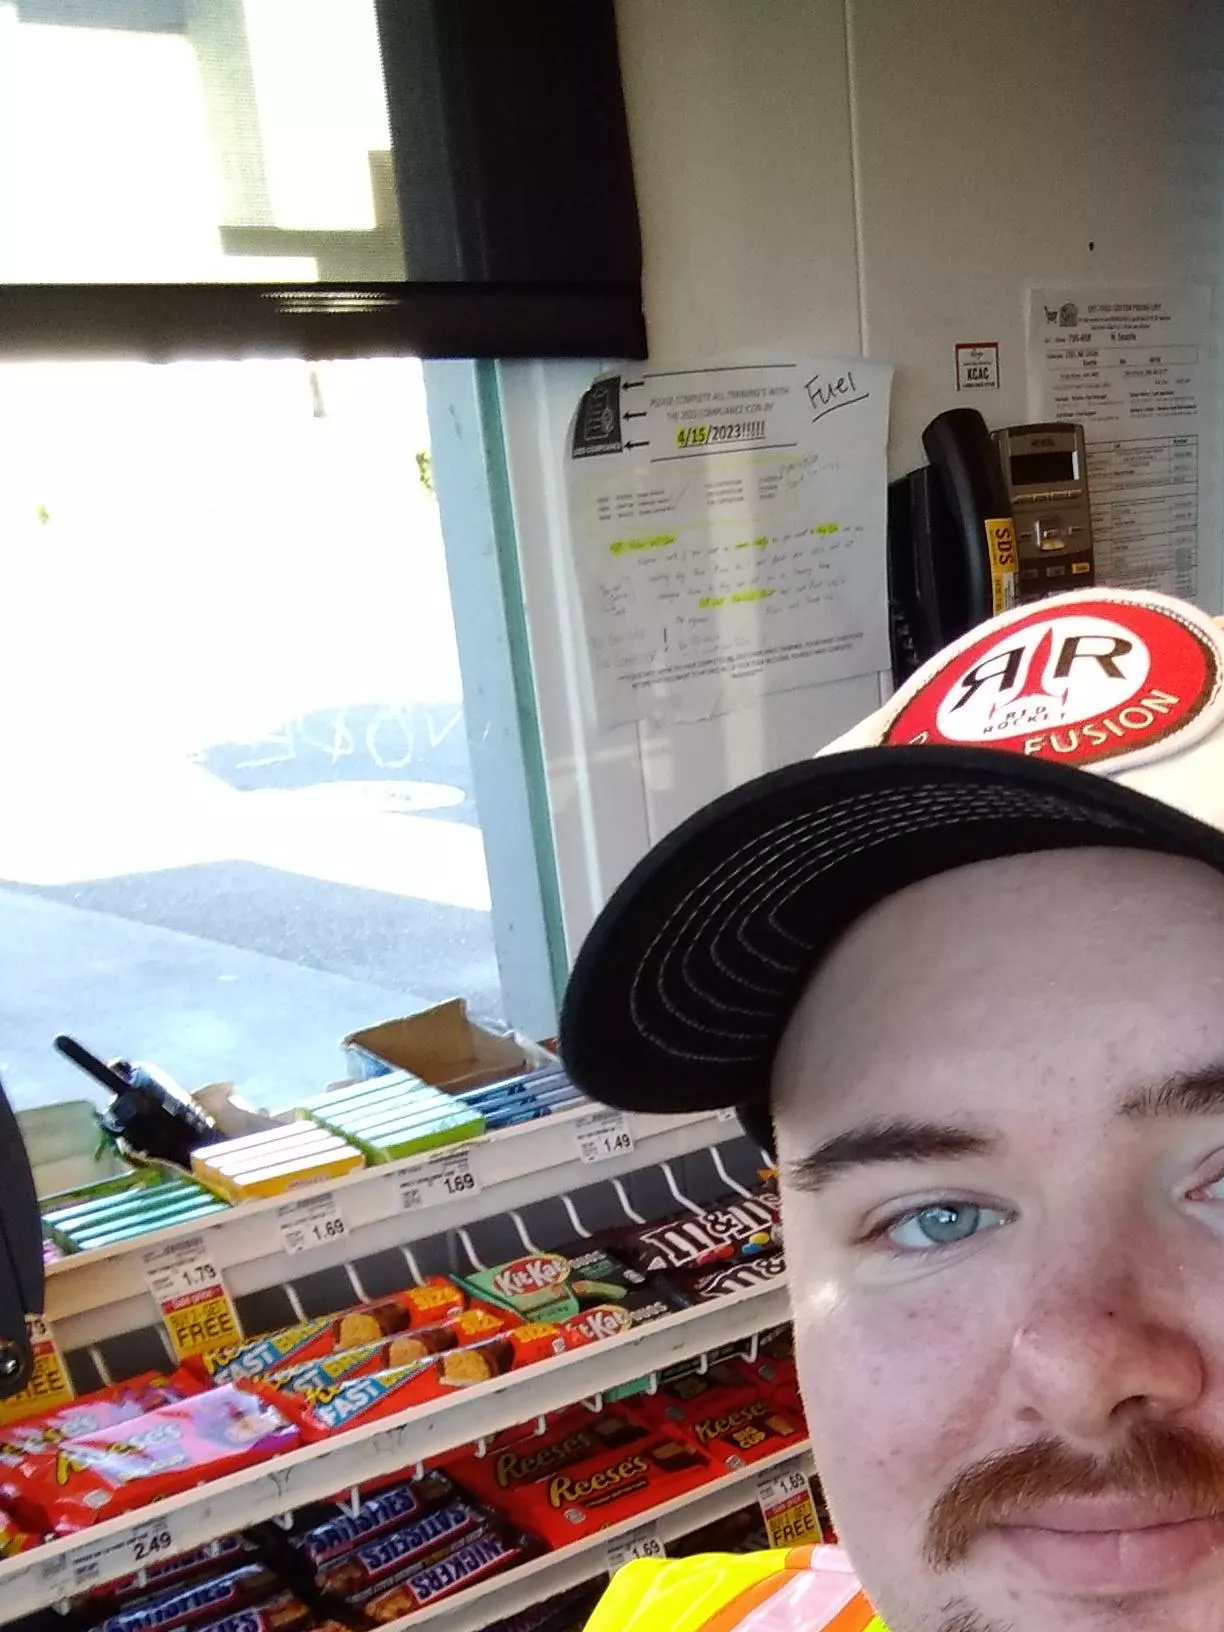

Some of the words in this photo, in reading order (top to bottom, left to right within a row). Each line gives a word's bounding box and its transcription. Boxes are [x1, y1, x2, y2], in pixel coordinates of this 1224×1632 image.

[804, 372, 856, 410] Fuel
[676, 420, 766, 448] 4/15/2023!!!!!
[995, 527, 1014, 566] SDS
[982, 711, 1067, 735] ROCKET
[1023, 688, 1181, 757] FUSION
[603, 1132, 632, 1153] 1.49
[443, 1173, 476, 1195] 1.69
[311, 1219, 345, 1241] 1.69
[182, 1263, 217, 1286] 1.79
[495, 1256, 564, 1297] KitKat
[177, 1312, 234, 1348] FREE
[212, 1340, 279, 1387] FAST
[316, 1379, 382, 1428] FAST
[549, 1455, 649, 1508] Reese's
[780, 1473, 806, 1495] 1.69
[132, 1531, 173, 1561] 2.49
[773, 1513, 815, 1547] FREE
[407, 1534, 506, 1602] NICKERS
